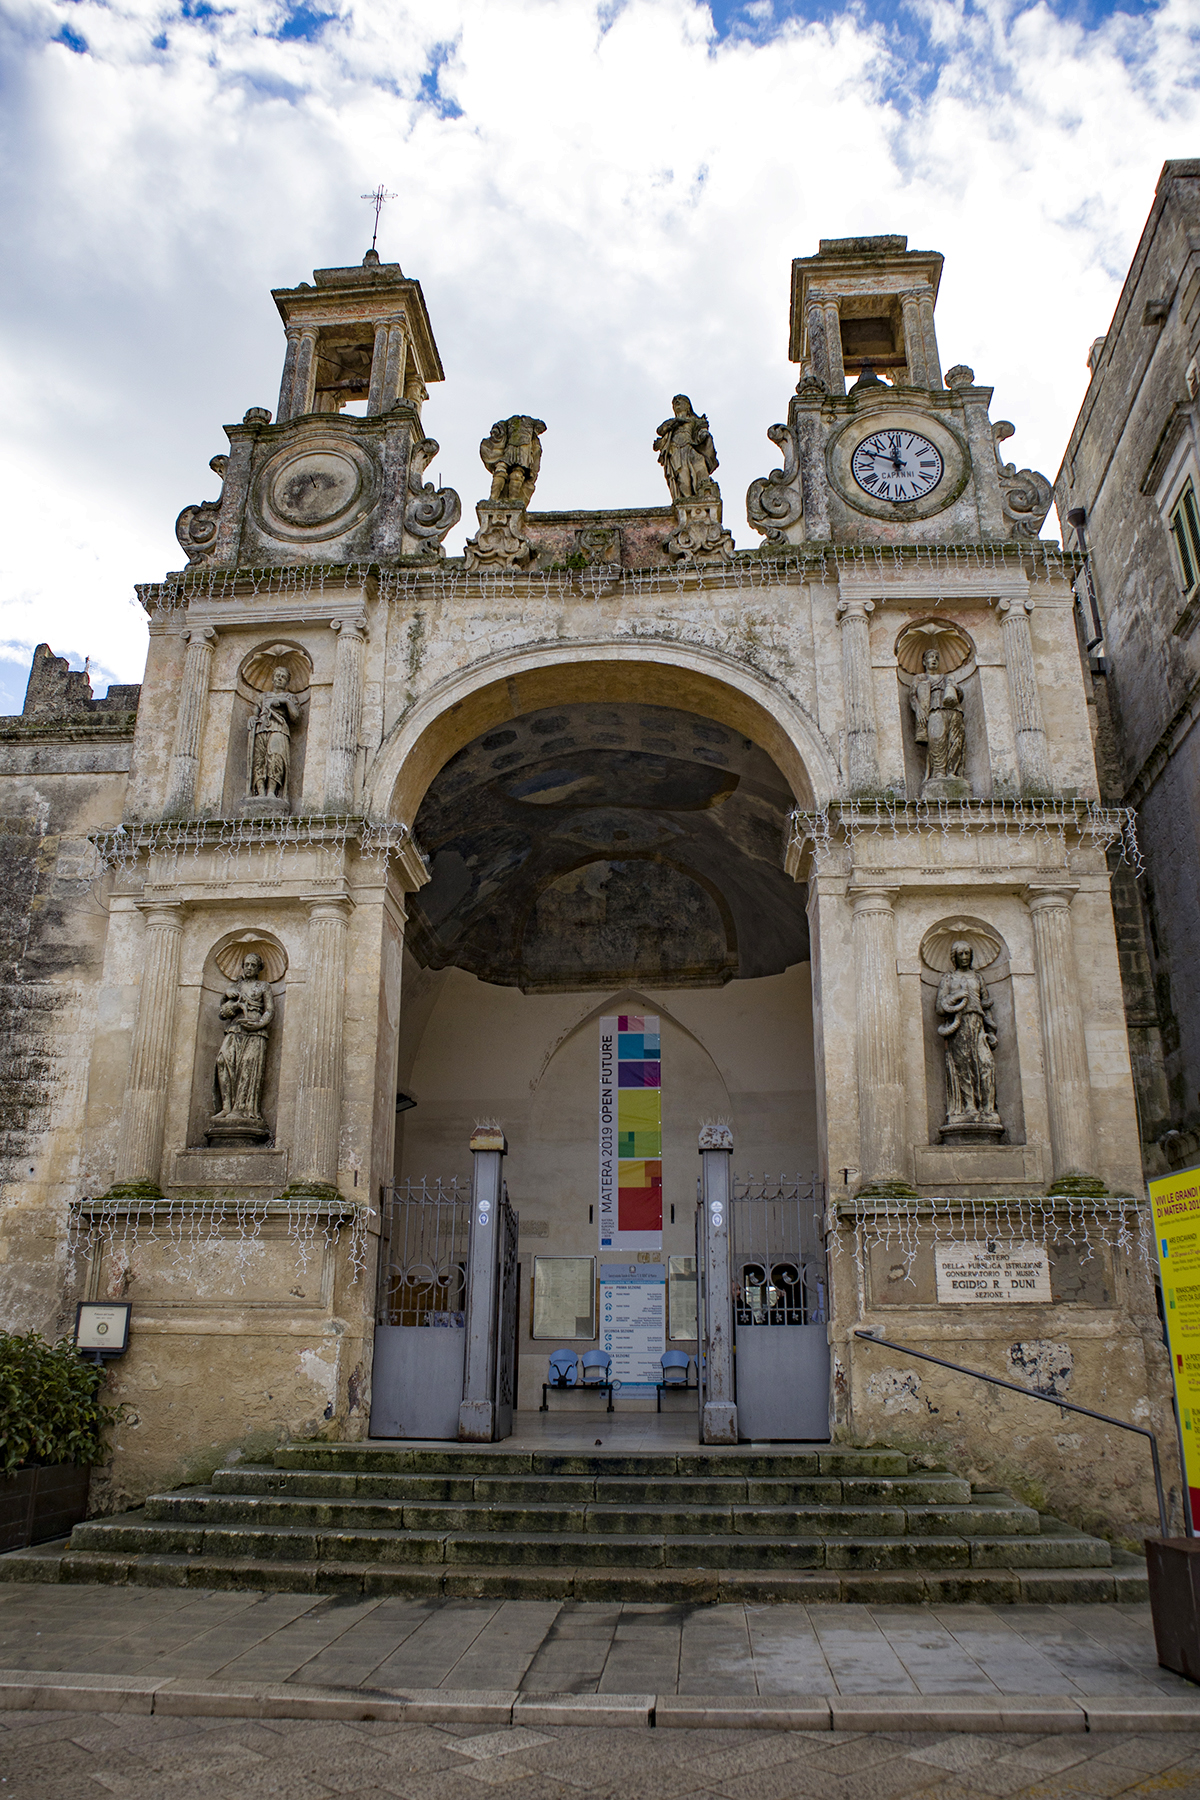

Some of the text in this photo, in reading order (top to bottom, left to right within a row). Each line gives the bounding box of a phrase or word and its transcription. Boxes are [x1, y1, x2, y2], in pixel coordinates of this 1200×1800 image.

[601, 1035, 613, 1084] FUTURE
[601, 1089, 613, 1123] OPEN
[601, 1127, 613, 1156] 2019
[601, 1159, 613, 1213] MATERA
[1154, 1186, 1198, 1206] VIVI LE GRANDI
[1157, 1198, 1200, 1218] DI MATERA 201
[952, 1280, 988, 1289] EGIDIO
[1011, 1279, 1036, 1288] DUNI
